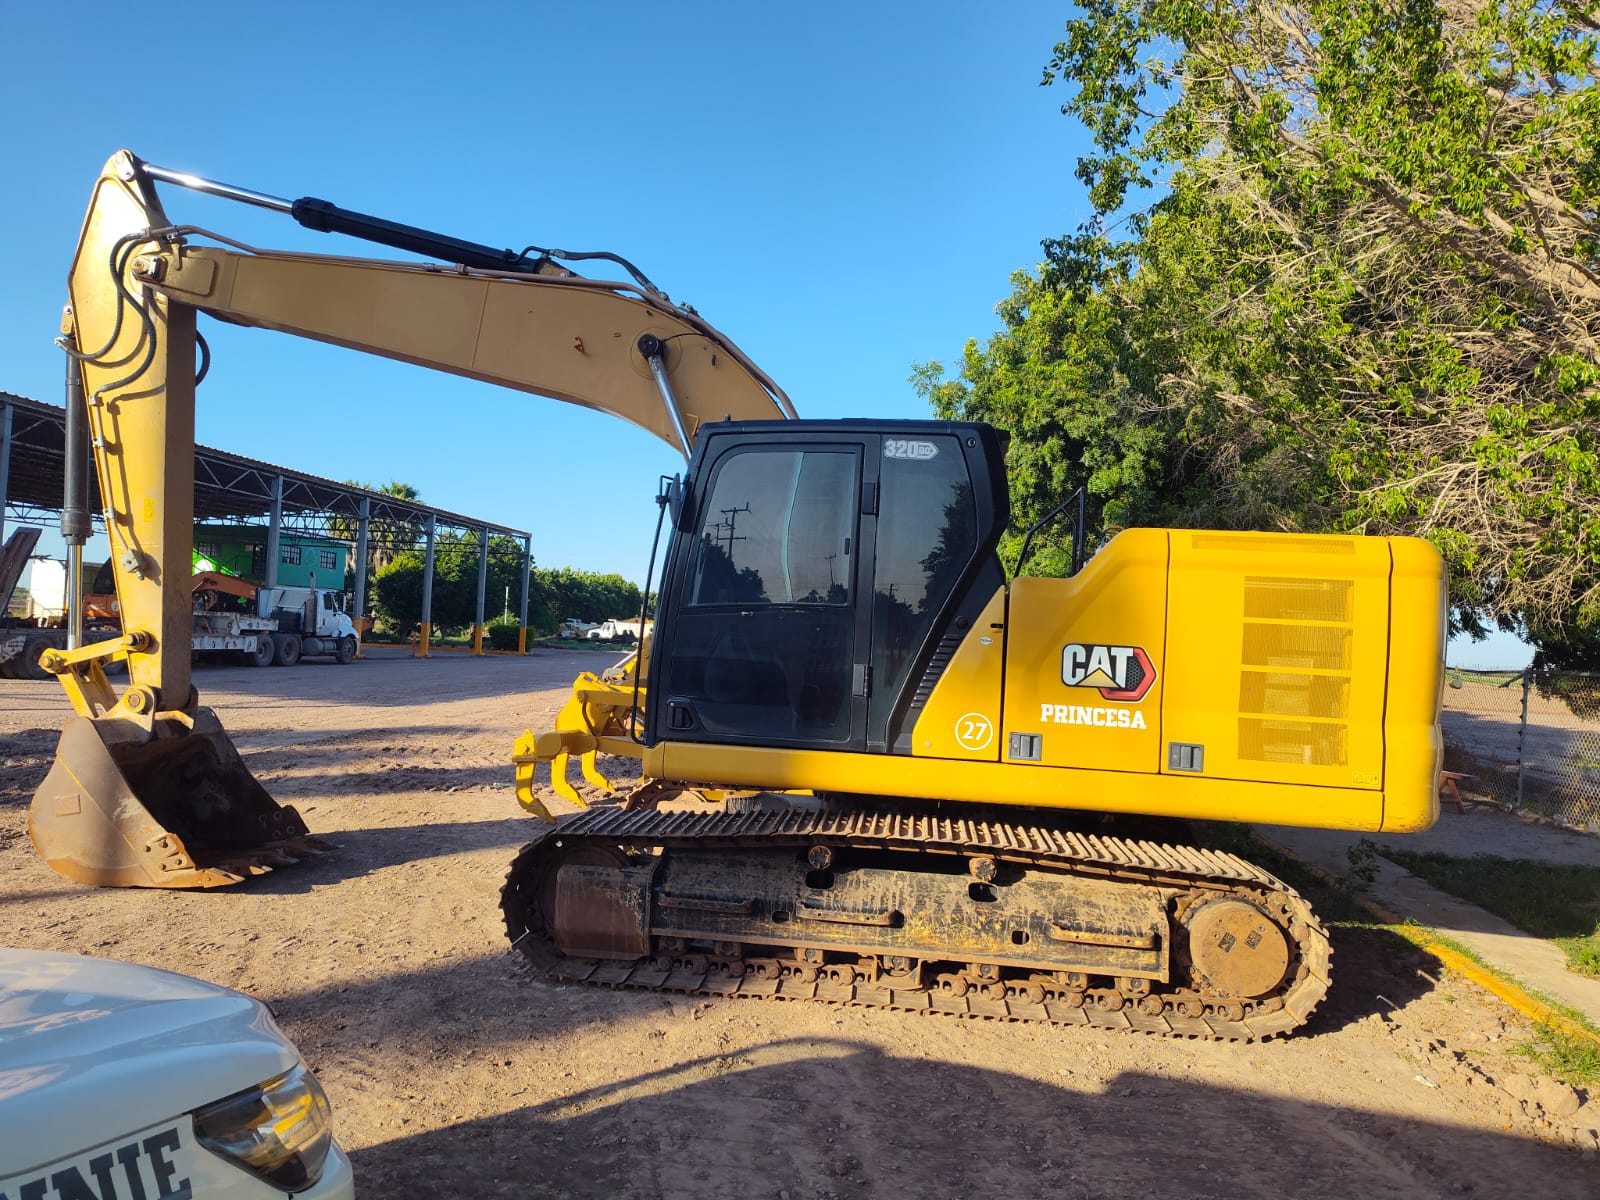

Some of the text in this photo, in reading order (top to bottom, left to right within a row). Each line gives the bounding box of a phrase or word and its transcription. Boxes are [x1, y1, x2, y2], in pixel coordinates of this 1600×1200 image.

[884, 439, 918, 458] 320
[1062, 644, 1134, 689] CAT
[1040, 703, 1147, 729] PRINCESA
[962, 721, 988, 741] 27
